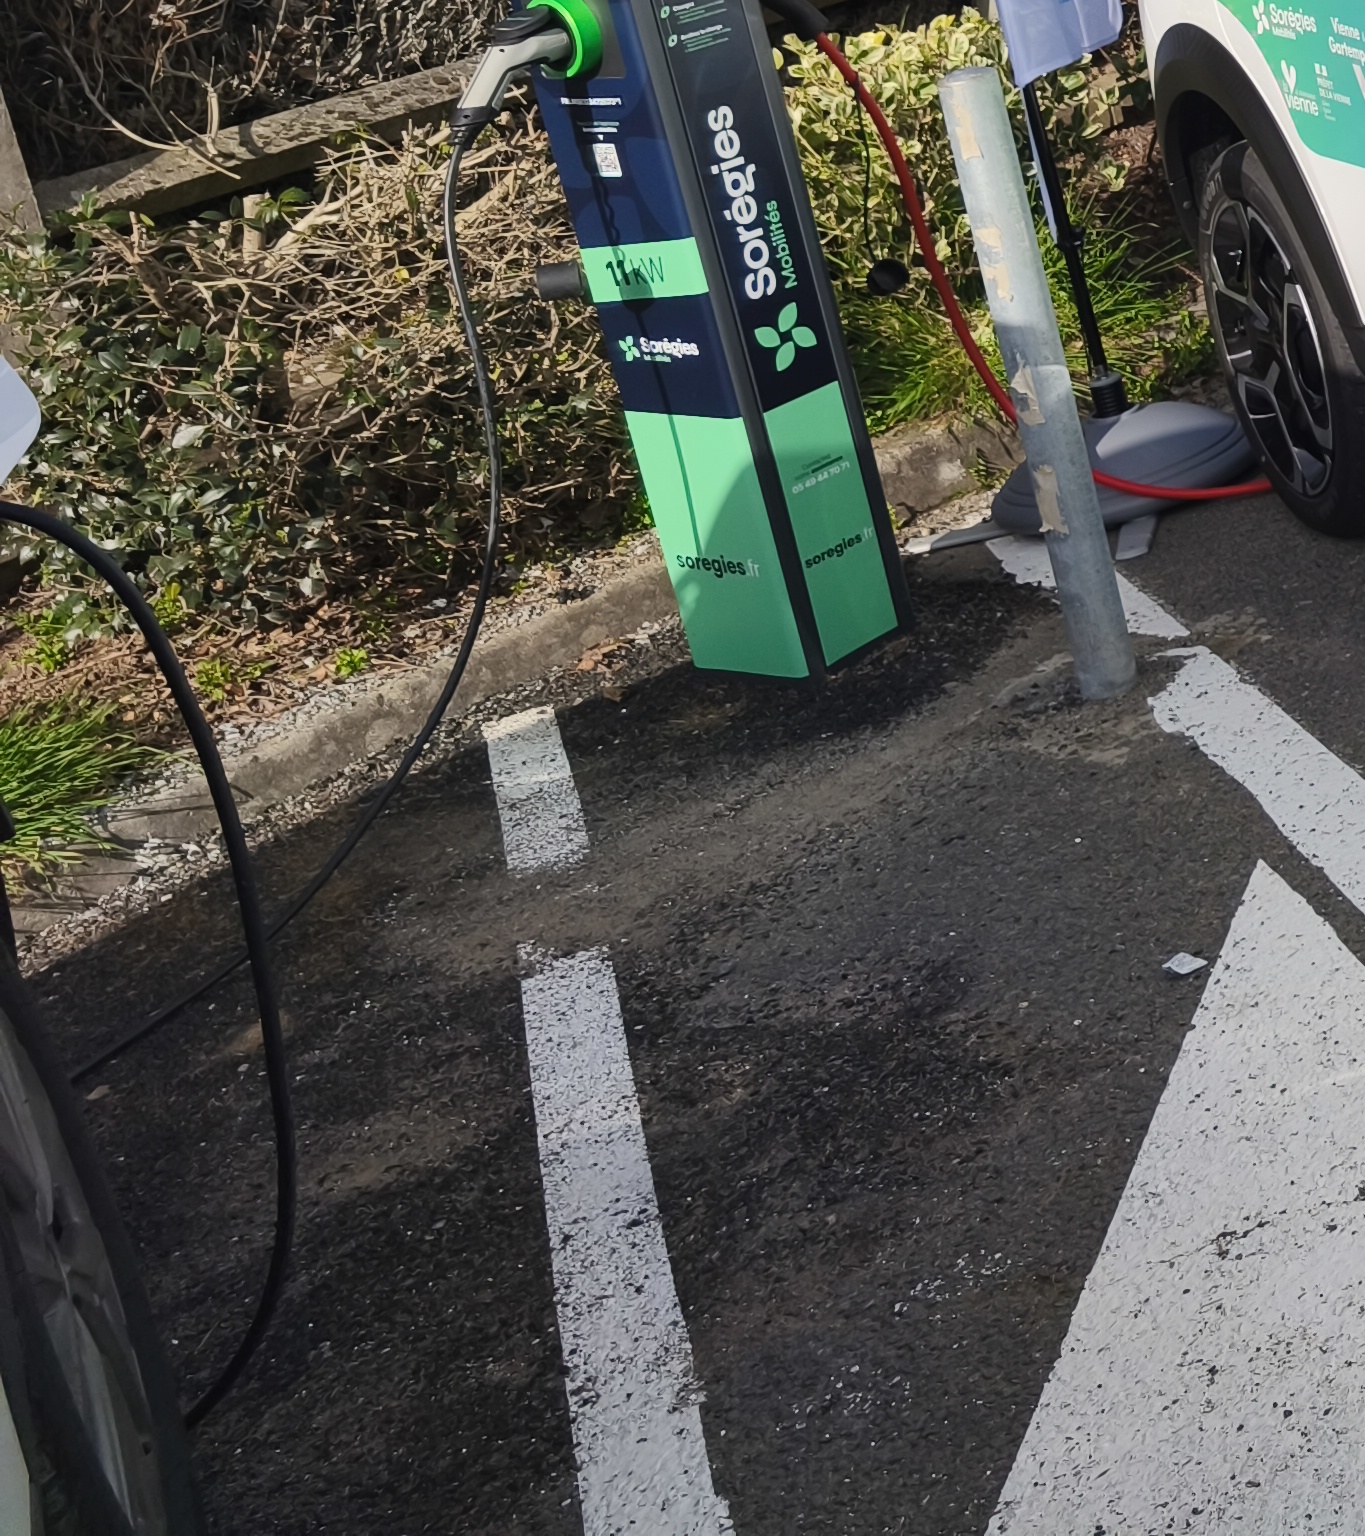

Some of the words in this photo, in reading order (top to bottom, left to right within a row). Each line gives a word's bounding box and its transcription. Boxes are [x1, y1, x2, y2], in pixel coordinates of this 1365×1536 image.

[1269, 2, 1317, 35] Sorégies
[1330, 16, 1361, 41] Vienne
[707, 105, 777, 300] Sorégies
[765, 199, 798, 290] Mobilités
[639, 336, 700, 359] Sorégies
[804, 526, 874, 569] soregies.fr
[676, 553, 760, 579] soregies.fr
